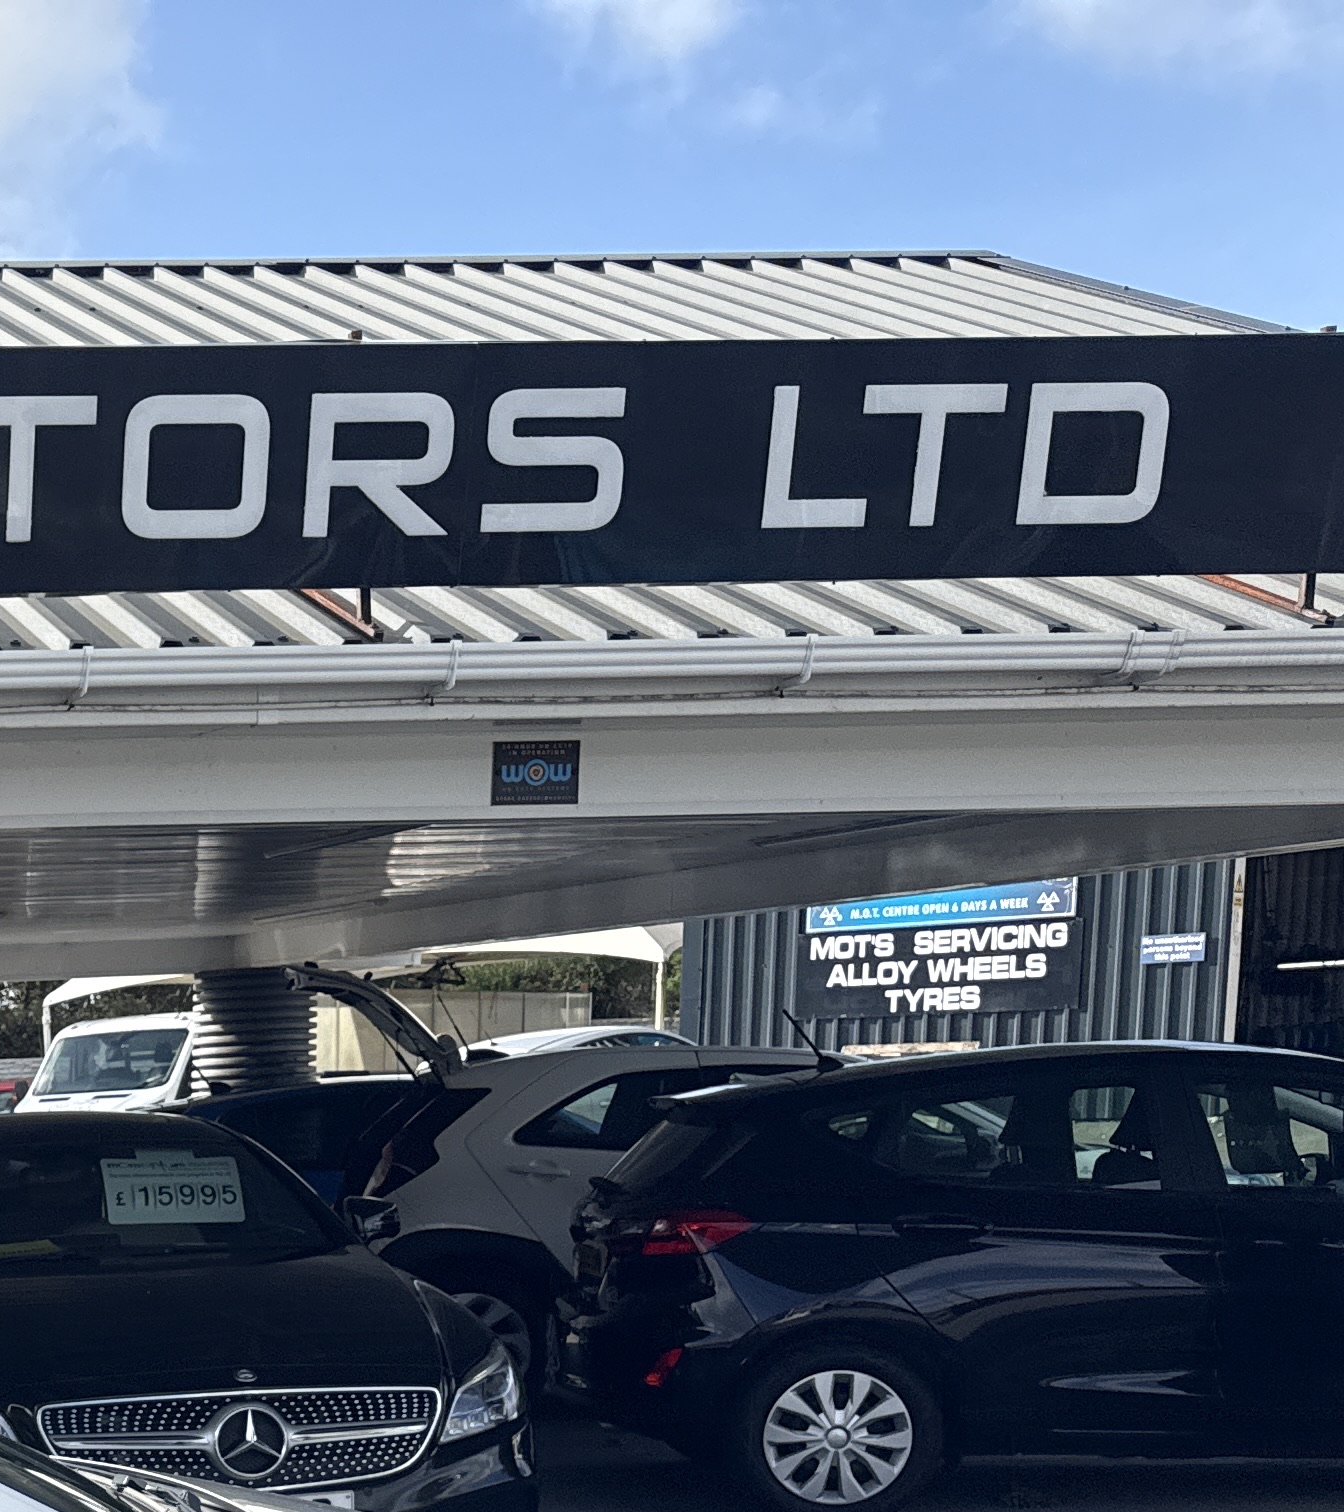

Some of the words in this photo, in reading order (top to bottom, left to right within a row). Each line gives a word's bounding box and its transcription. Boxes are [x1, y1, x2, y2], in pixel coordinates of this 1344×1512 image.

[760, 382, 1170, 529] LTD
[882, 904, 920, 918] CENTRE
[921, 902, 950, 915] OPEN
[951, 902, 959, 913] 6
[961, 899, 988, 912] DAYS
[989, 899, 998, 911] A
[1000, 897, 1029, 910] WEEK
[810, 933, 895, 960] MOT'S
[913, 922, 1068, 955] SERVICING
[826, 960, 918, 988] ALLOY
[927, 952, 1047, 983] WHEELS
[884, 985, 981, 1013] TYRES
[116, 1191, 126, 1206] £
[138, 1184, 237, 1207] 15995
